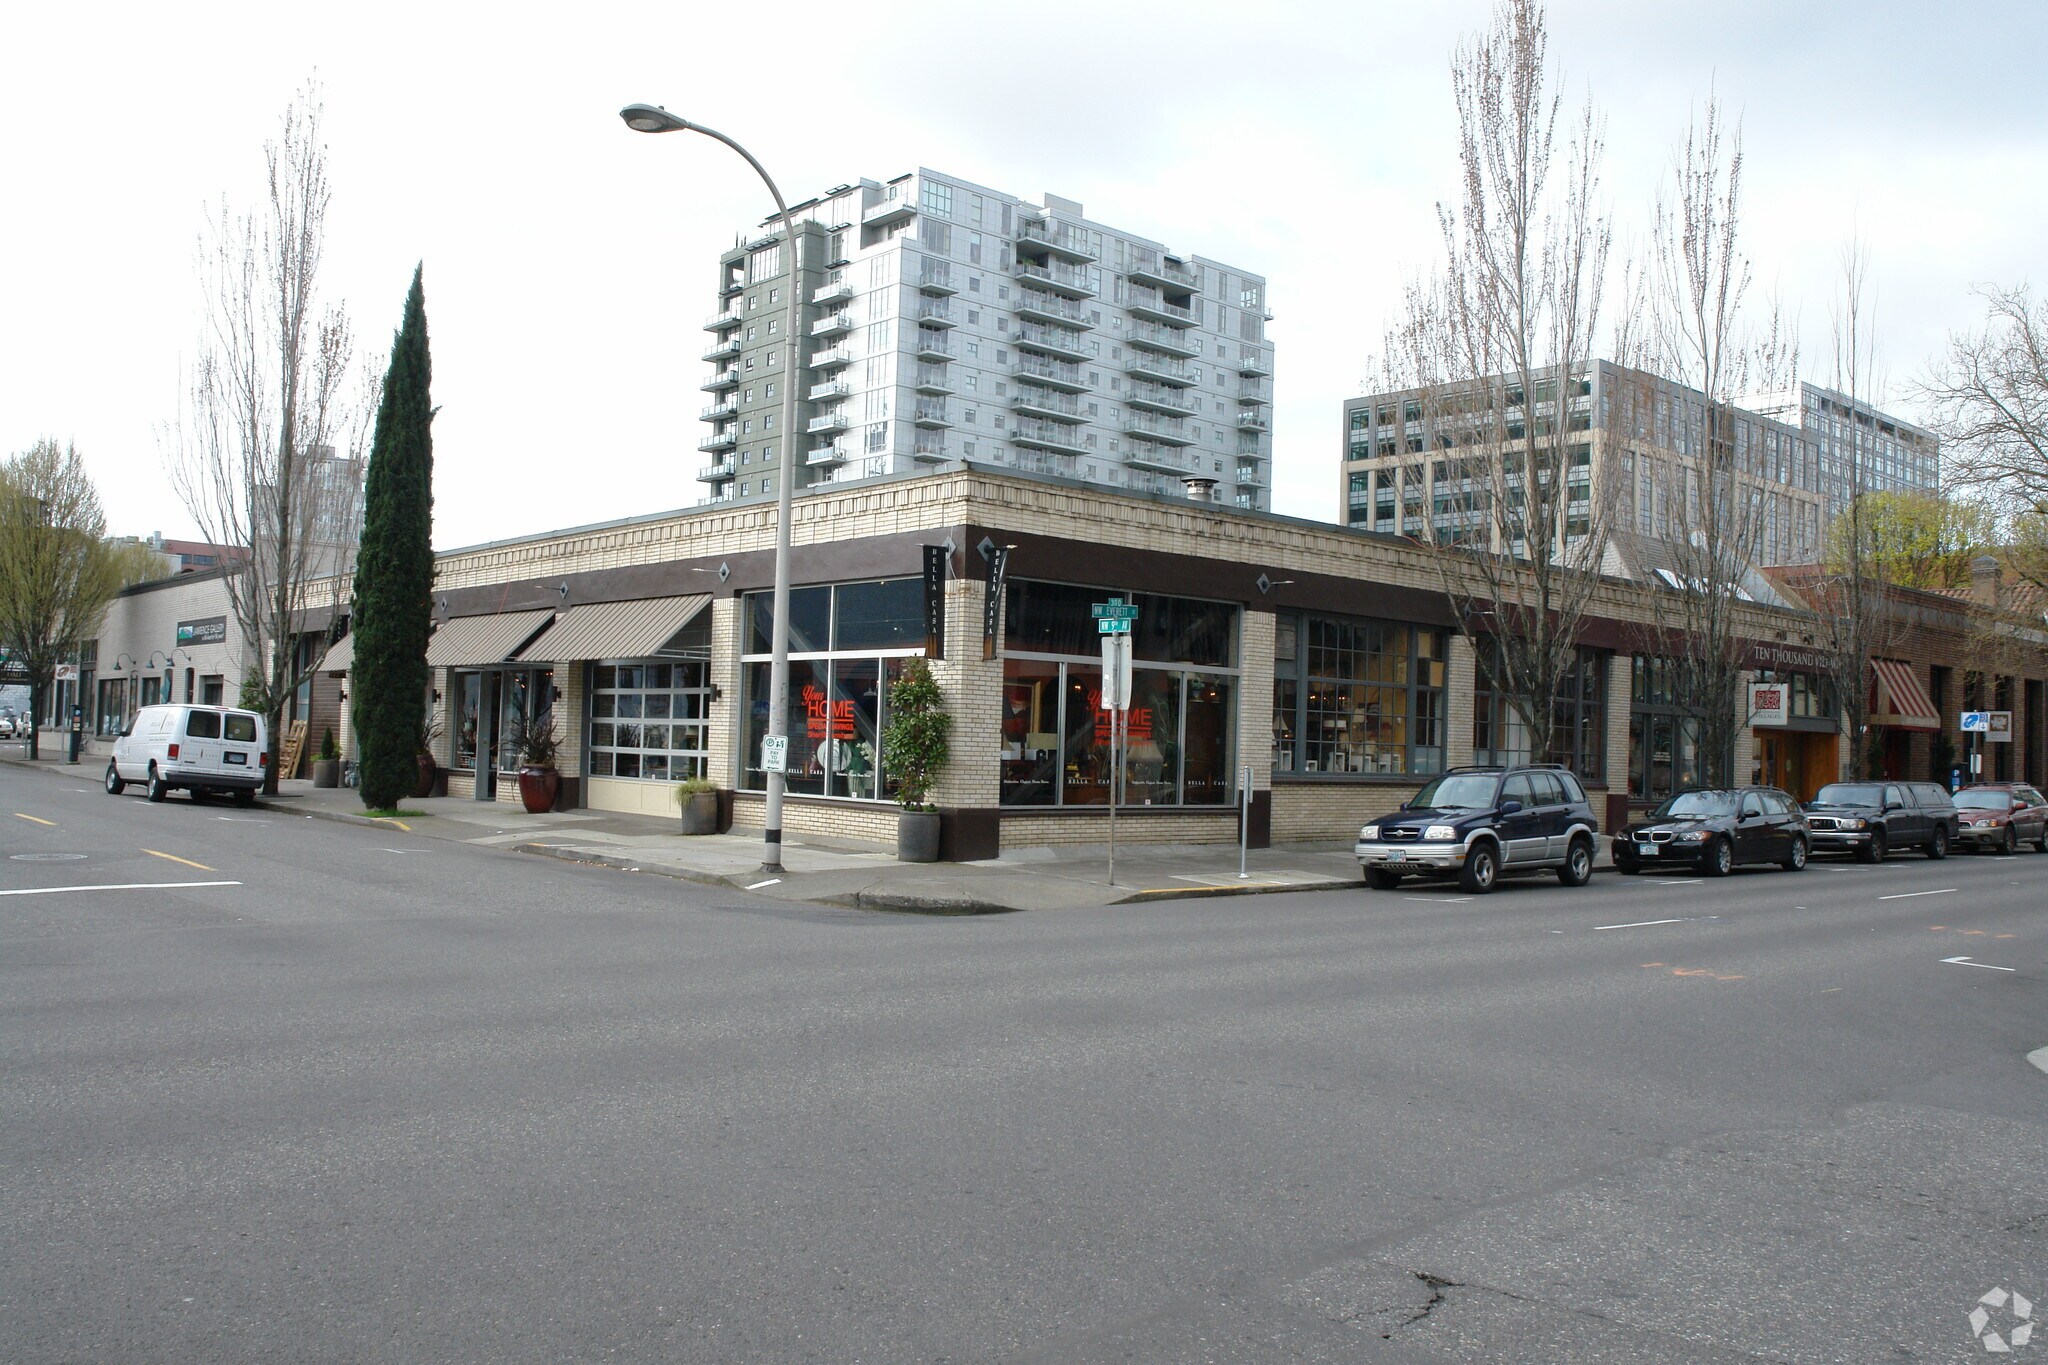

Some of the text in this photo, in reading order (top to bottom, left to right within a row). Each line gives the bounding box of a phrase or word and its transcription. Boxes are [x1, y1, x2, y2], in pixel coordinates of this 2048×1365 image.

[991, 549, 1001, 592] BELLA
[1106, 606, 1128, 617] EVERETT
[1754, 646, 1770, 660] TEN
[1772, 648, 1813, 667] THOUSAND
[802, 685, 824, 705] Your
[807, 700, 855, 718] HOME
